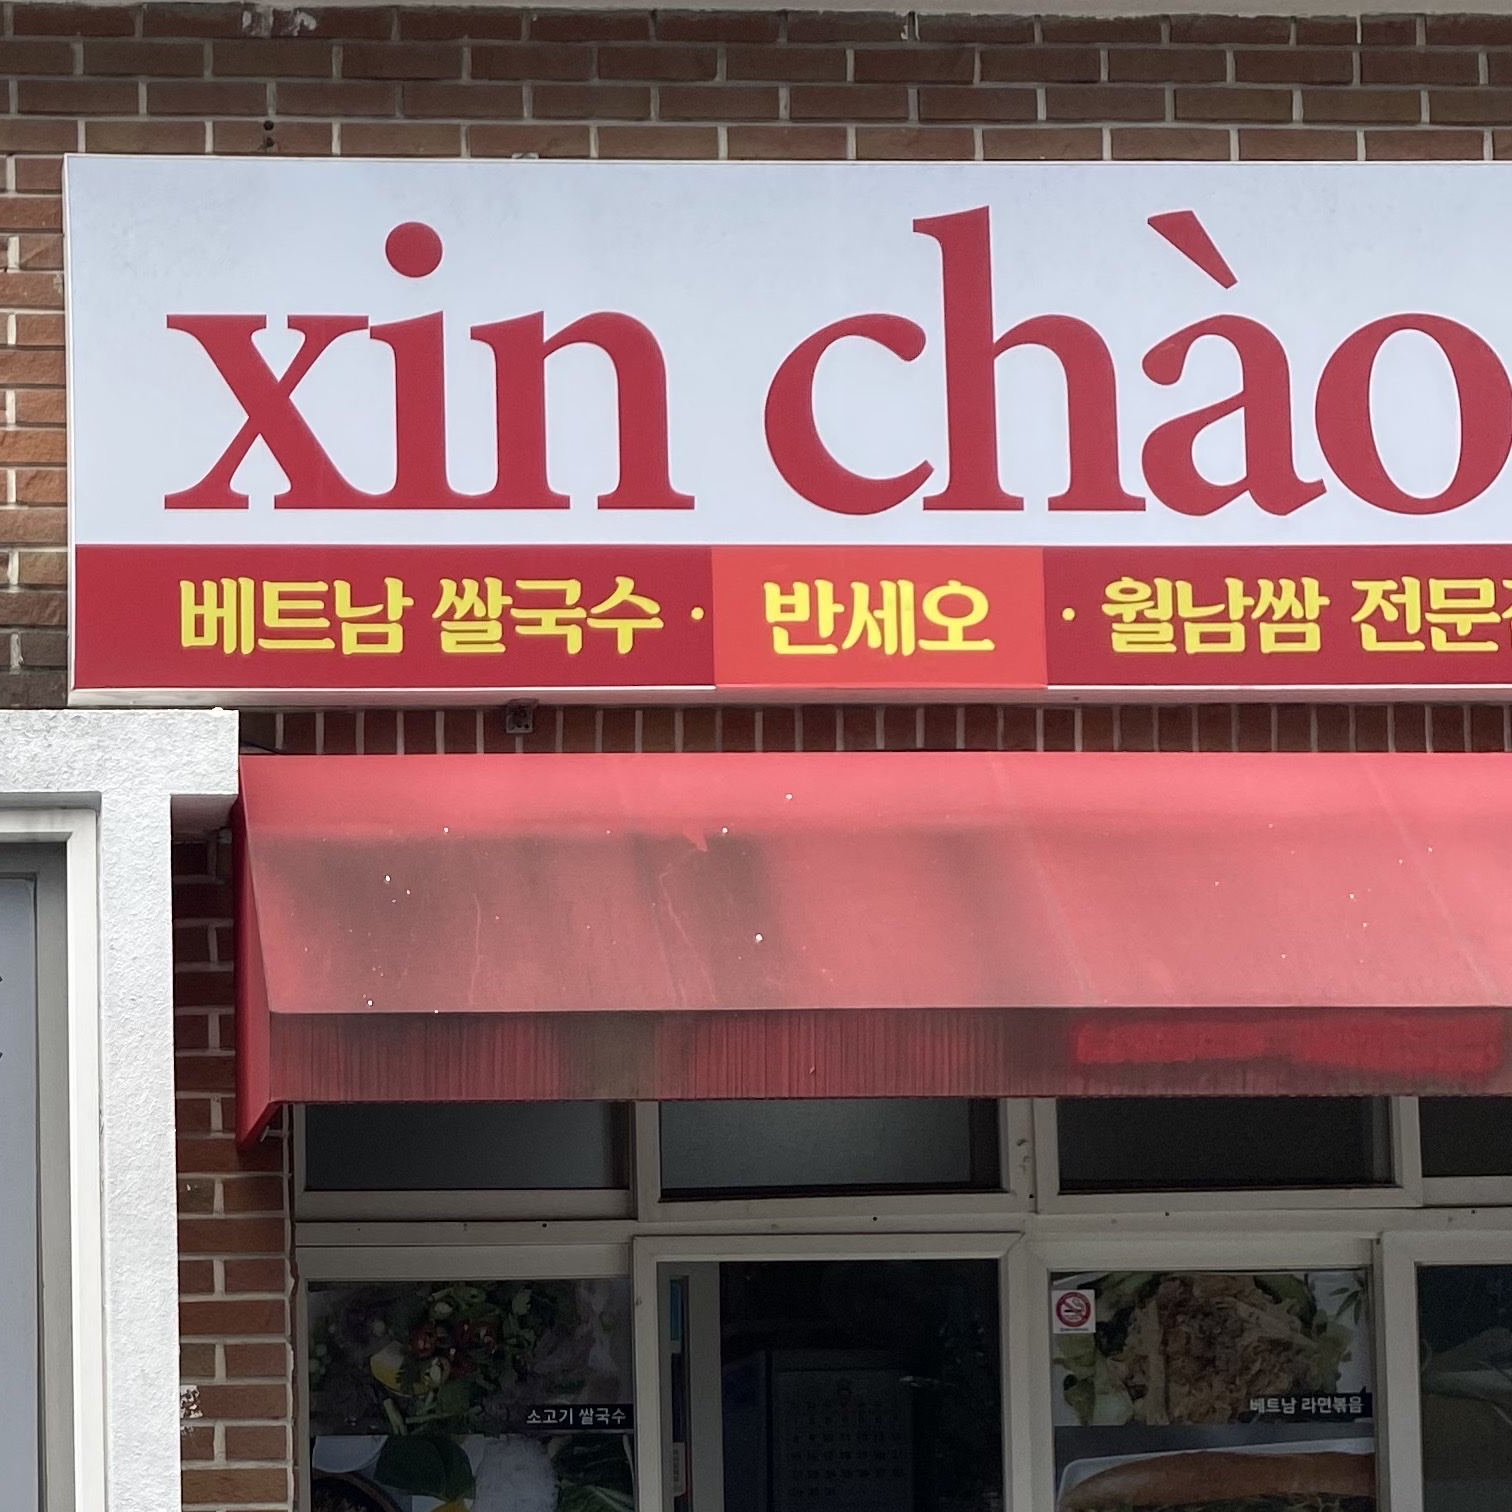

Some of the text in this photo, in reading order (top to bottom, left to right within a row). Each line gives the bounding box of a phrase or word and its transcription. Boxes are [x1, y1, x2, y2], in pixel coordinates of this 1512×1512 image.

[165, 205, 1512, 517] xin chào
[180, 576, 1512, 656] 베트남 쌀국수 반세오 월남쌈 전문
[526, 1407, 627, 1425] 소고기 쌀국수
[1249, 1397, 1297, 1415] 베트남
